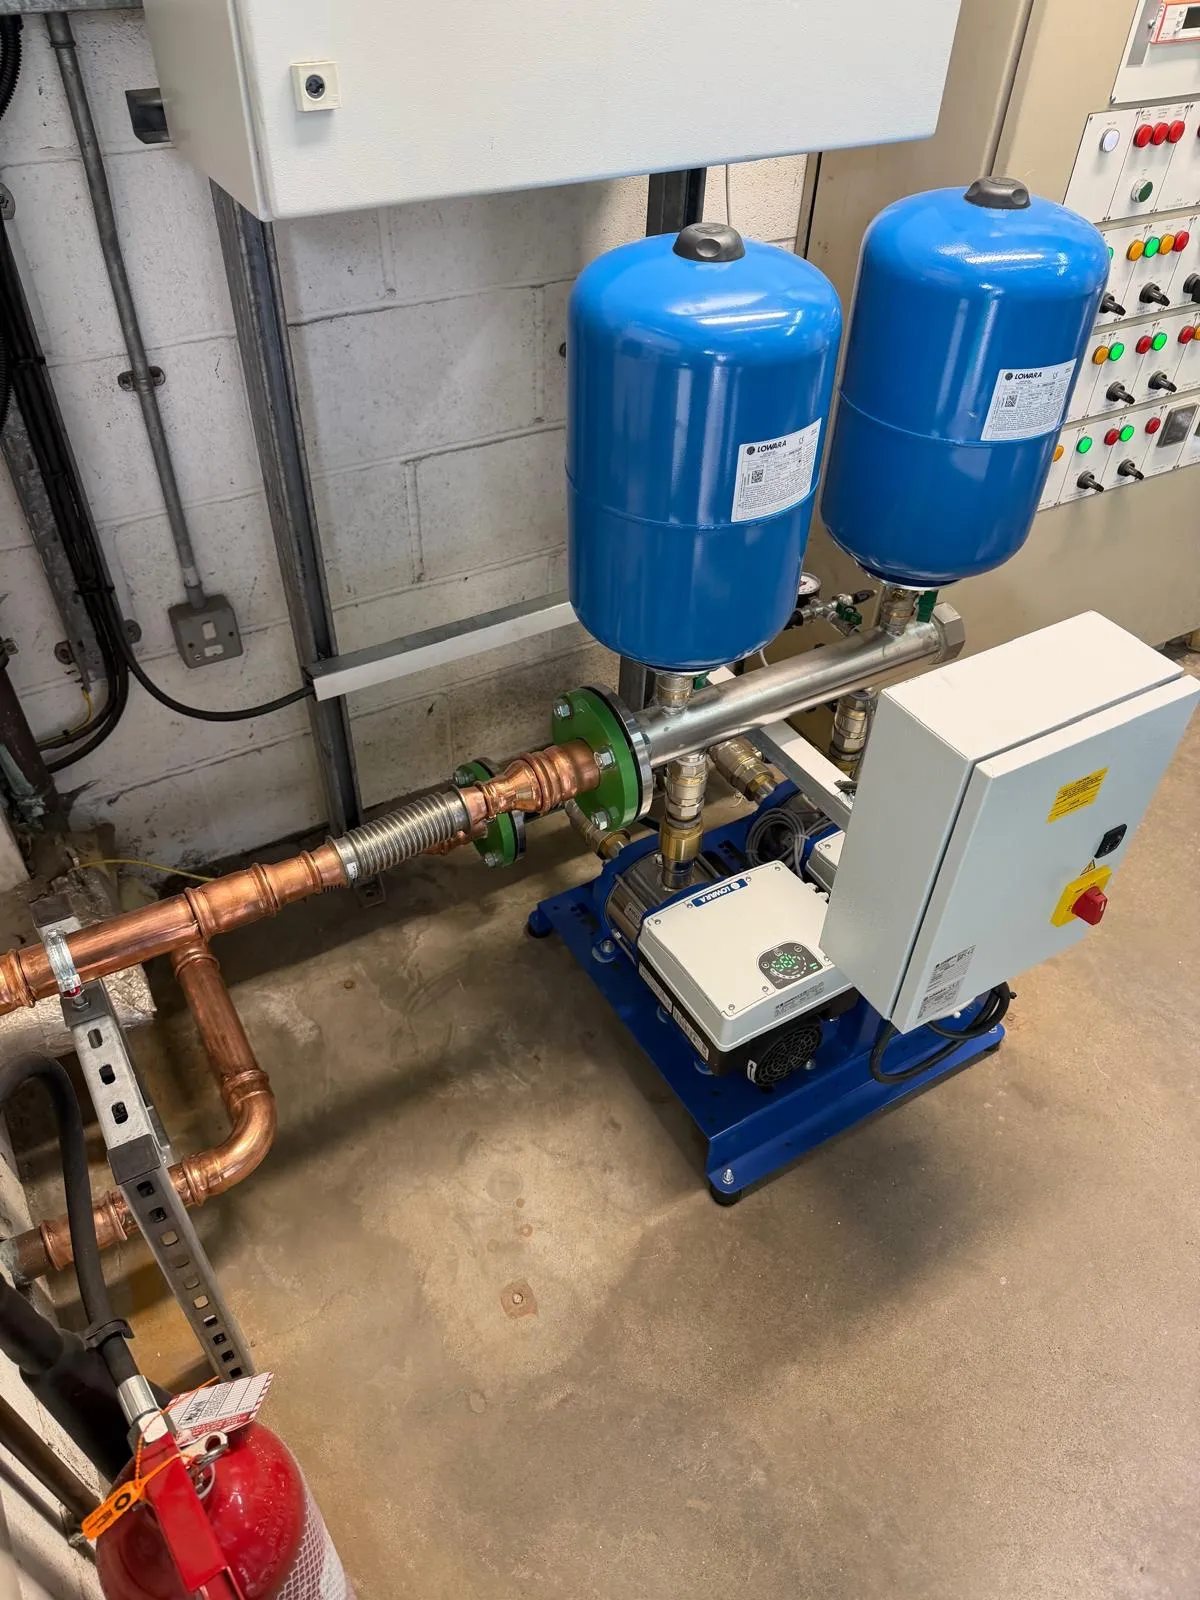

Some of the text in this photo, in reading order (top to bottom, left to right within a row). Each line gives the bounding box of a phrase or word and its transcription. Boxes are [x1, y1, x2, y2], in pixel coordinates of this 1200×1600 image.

[1014, 371, 1043, 380] LOWARA
[757, 440, 787, 453] LOWARA
[699, 885, 731, 903] LOWARA
